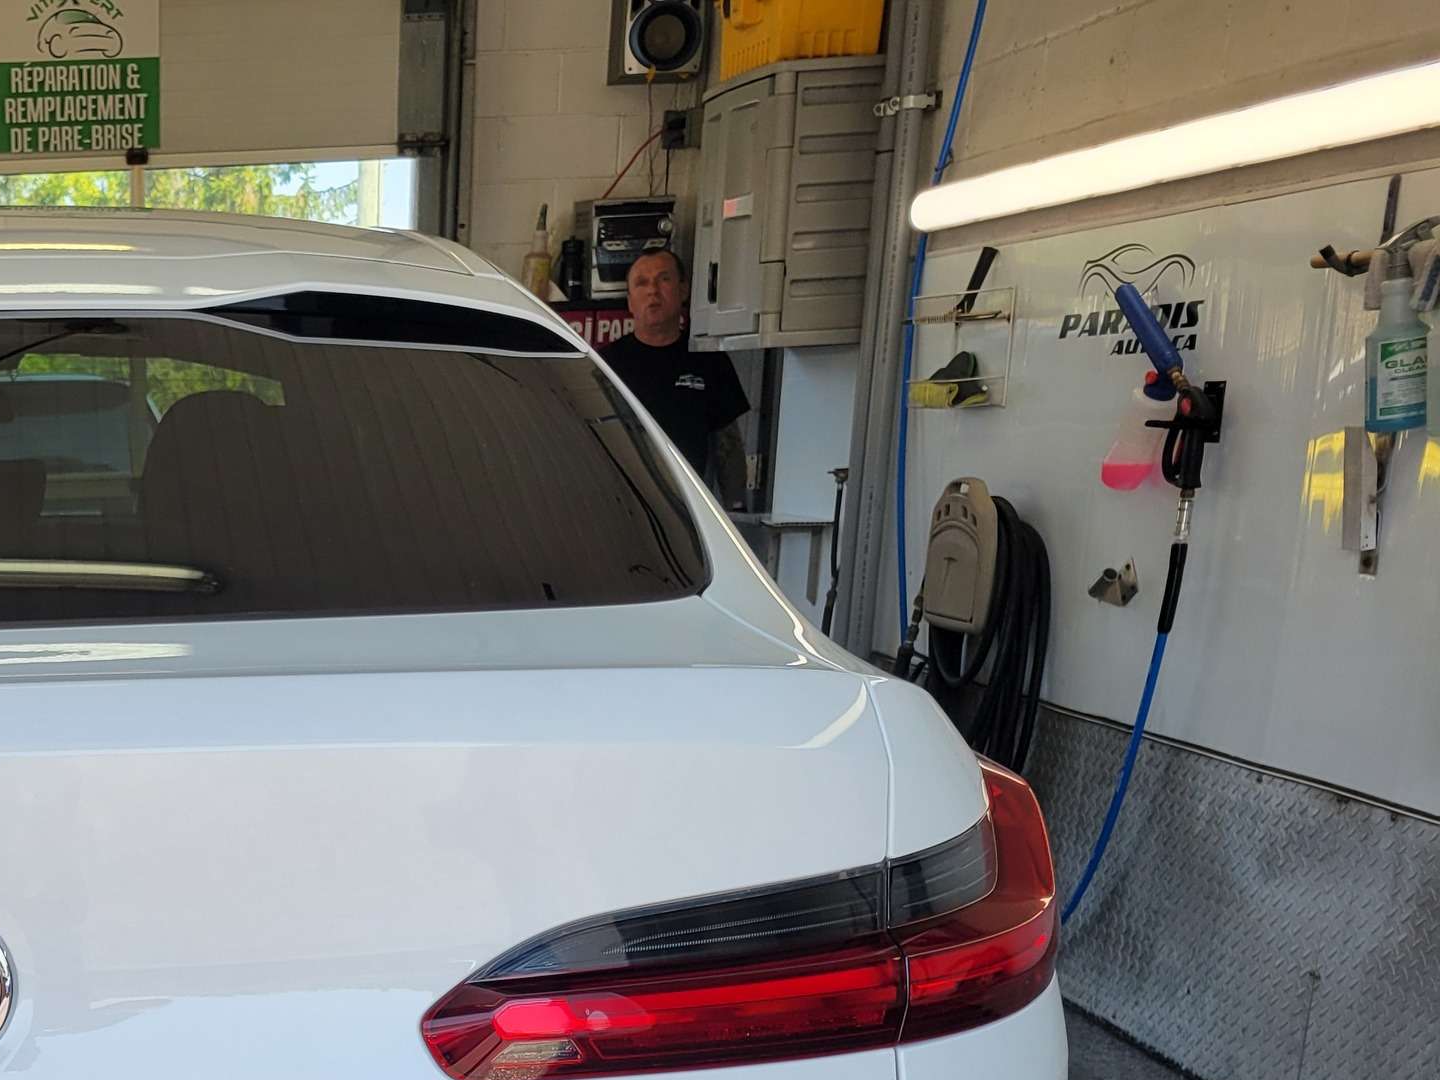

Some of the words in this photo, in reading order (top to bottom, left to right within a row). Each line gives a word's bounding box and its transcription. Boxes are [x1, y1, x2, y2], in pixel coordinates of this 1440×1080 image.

[11, 61, 121, 93] RÉPARATION
[126, 64, 141, 89] &
[5, 93, 148, 123] REMPLACEMENT
[11, 127, 33, 153] DE
[38, 123, 144, 151] PARE-BRISE
[1059, 300, 1205, 339] PARDIS
